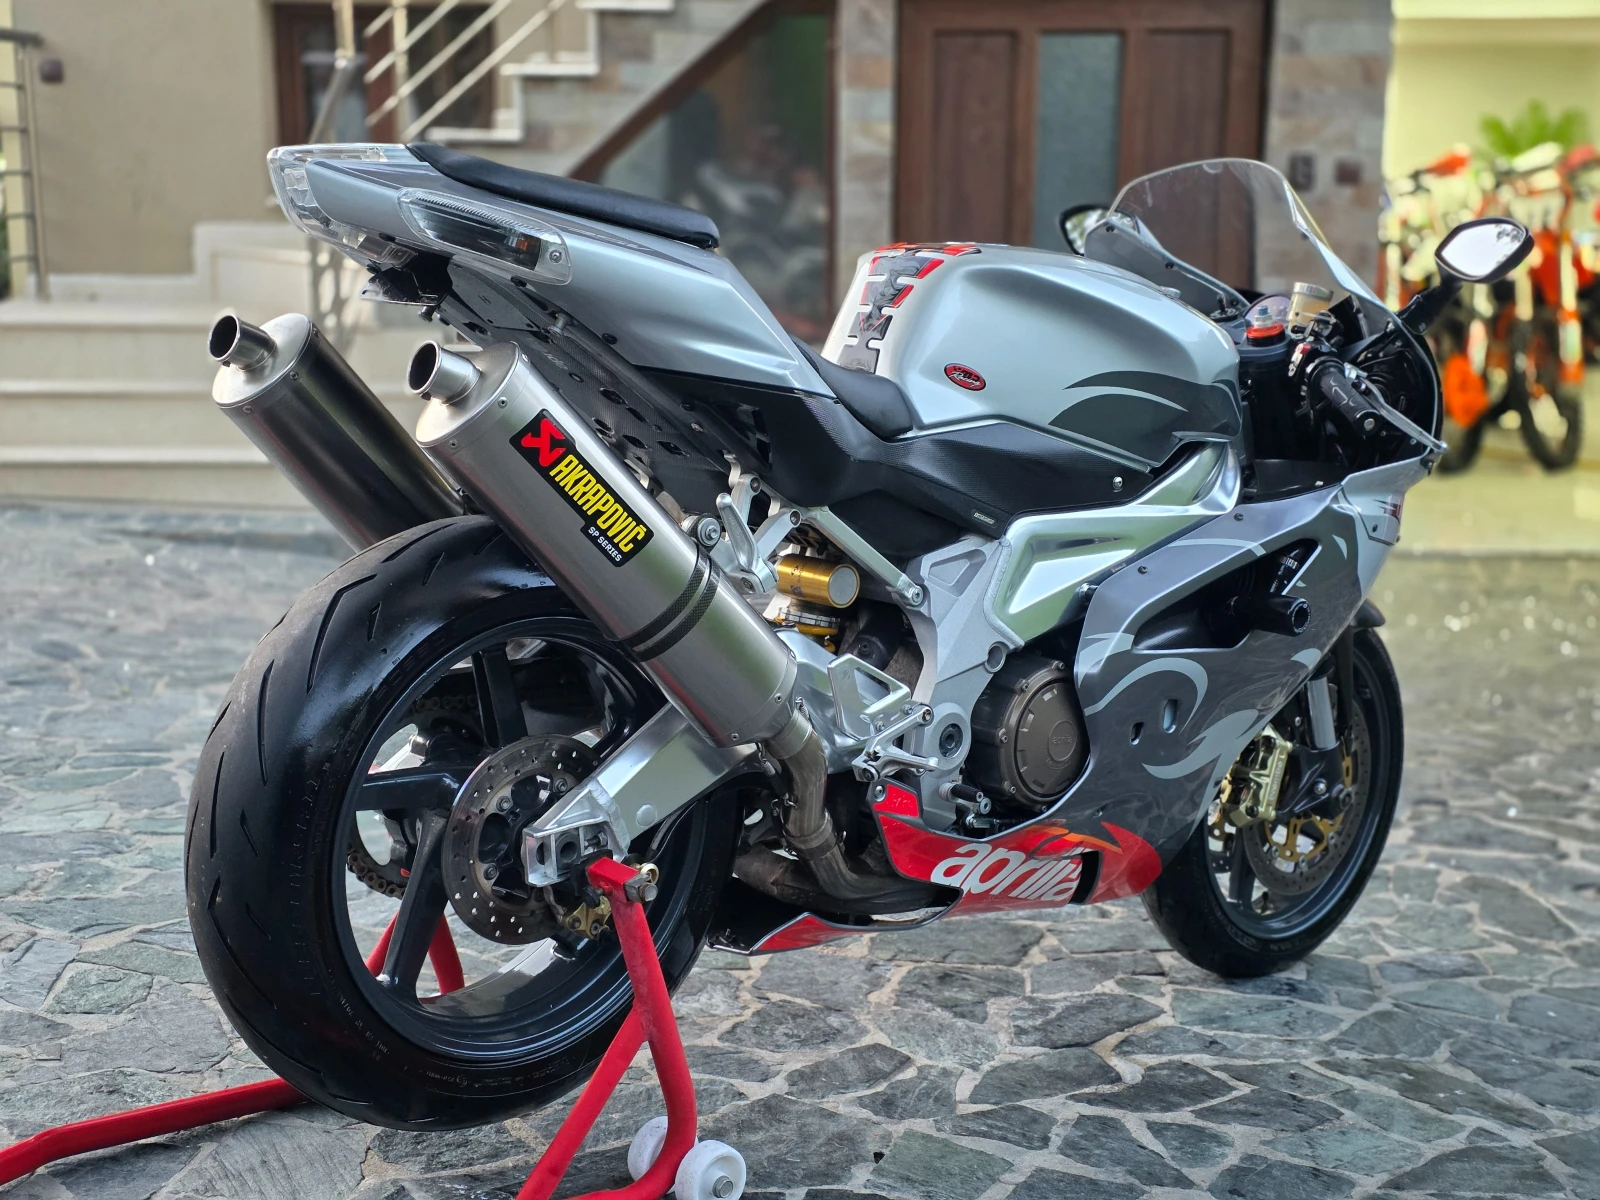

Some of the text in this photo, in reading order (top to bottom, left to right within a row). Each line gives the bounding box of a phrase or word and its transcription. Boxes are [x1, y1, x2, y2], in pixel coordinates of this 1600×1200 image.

[588, 526, 622, 562] SP SERIES
[930, 843, 1094, 901] aprilia
